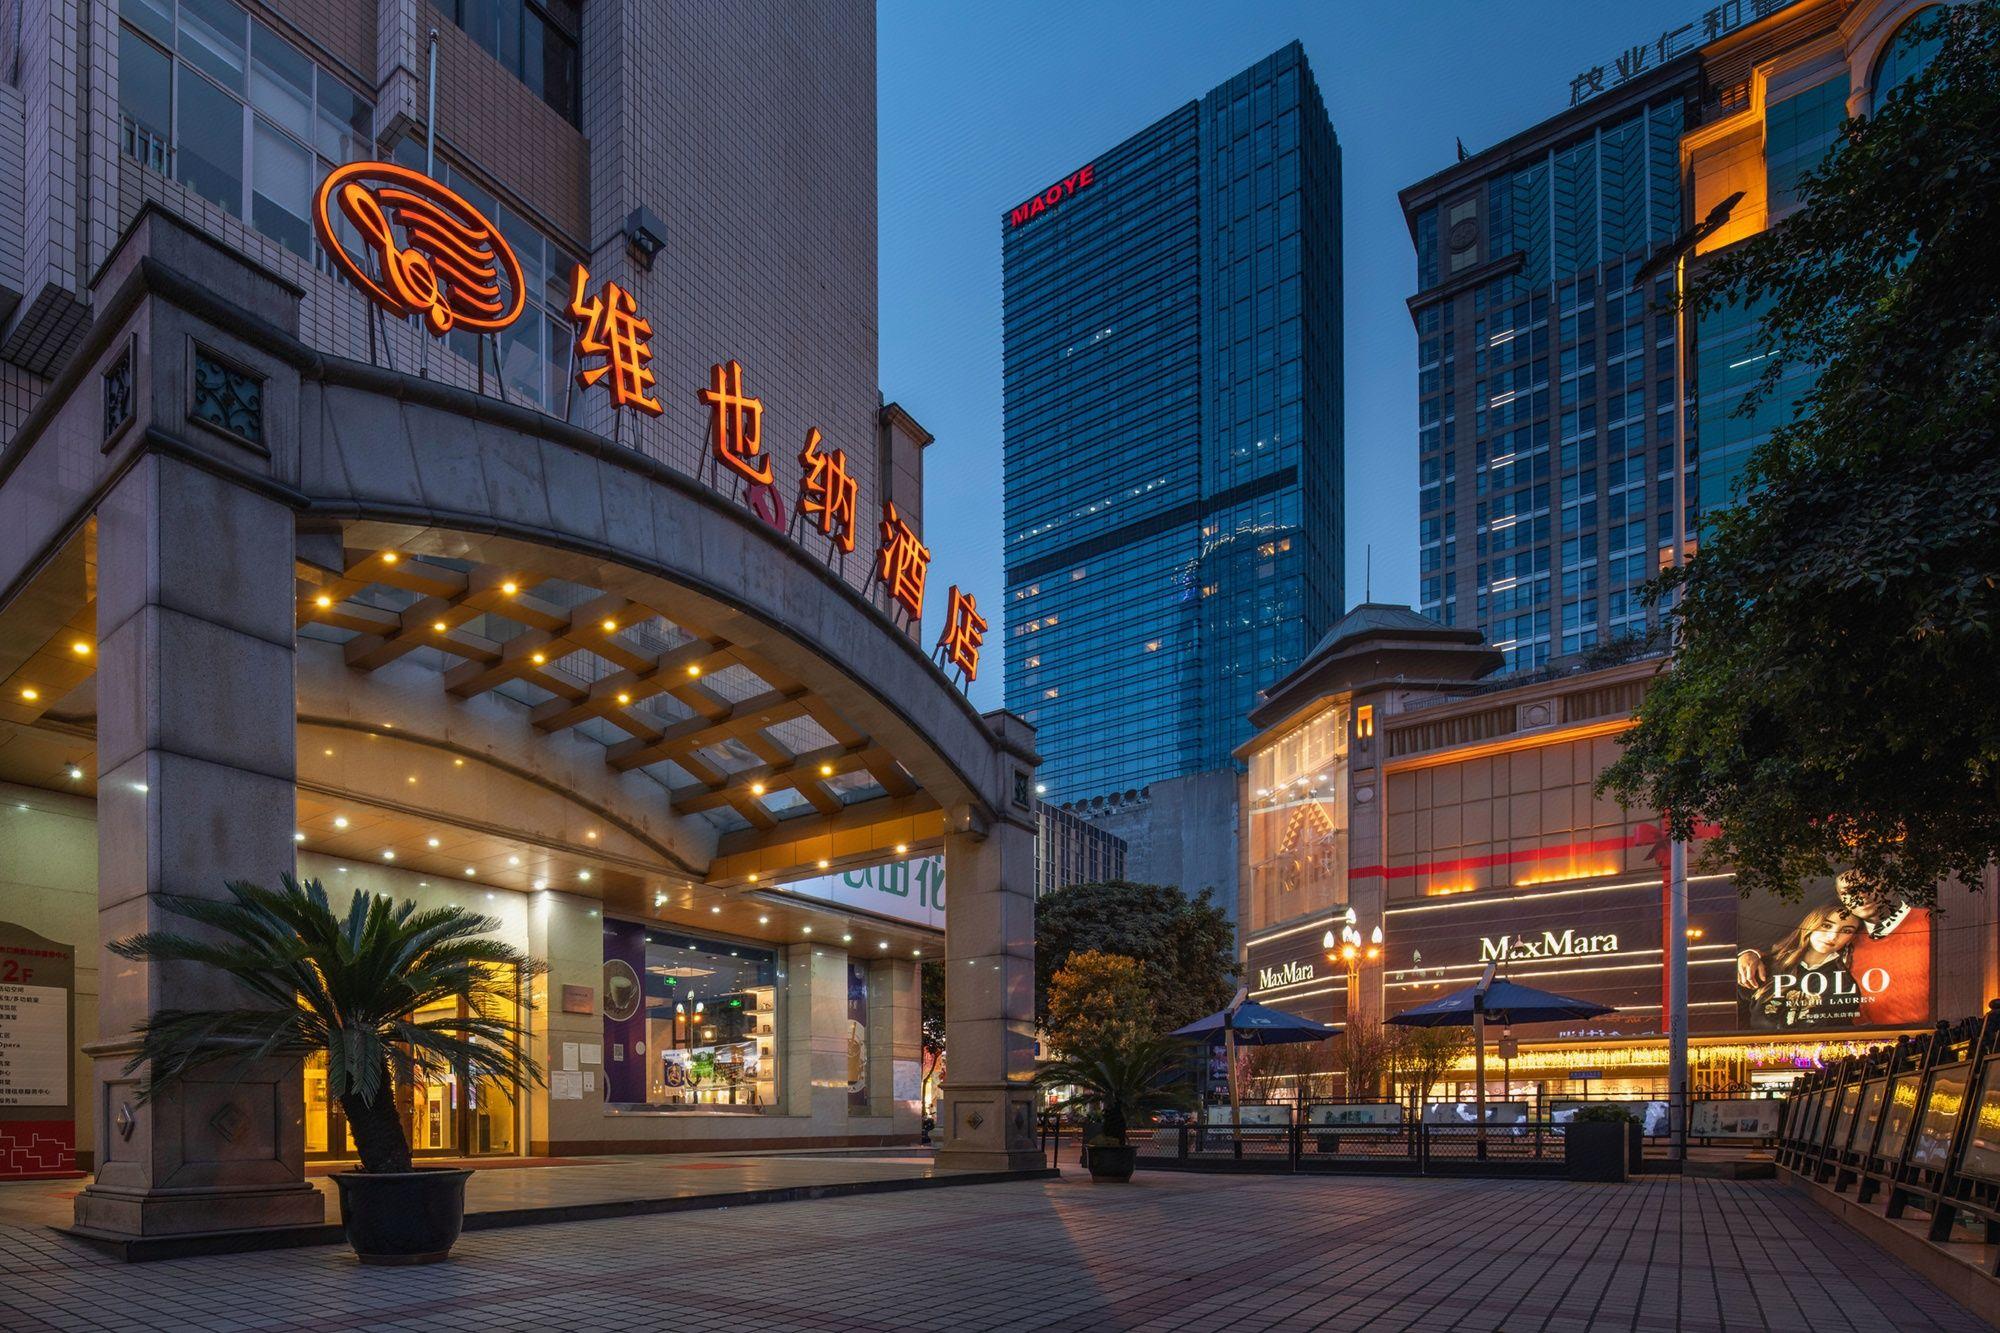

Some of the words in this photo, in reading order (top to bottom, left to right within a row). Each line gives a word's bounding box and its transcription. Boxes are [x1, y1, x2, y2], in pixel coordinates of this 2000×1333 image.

[1010, 165, 1095, 228] MAOYE
[564, 262, 988, 683] 维也纳酒店
[1479, 929, 1618, 962] MaxMara
[3, 959, 34, 983] 2F
[1259, 961, 1314, 990] MaxMara
[1773, 967, 1891, 999] POLO
[1785, 998, 1823, 1008] RALPH
[1829, 996, 1876, 1006] LAUREN
